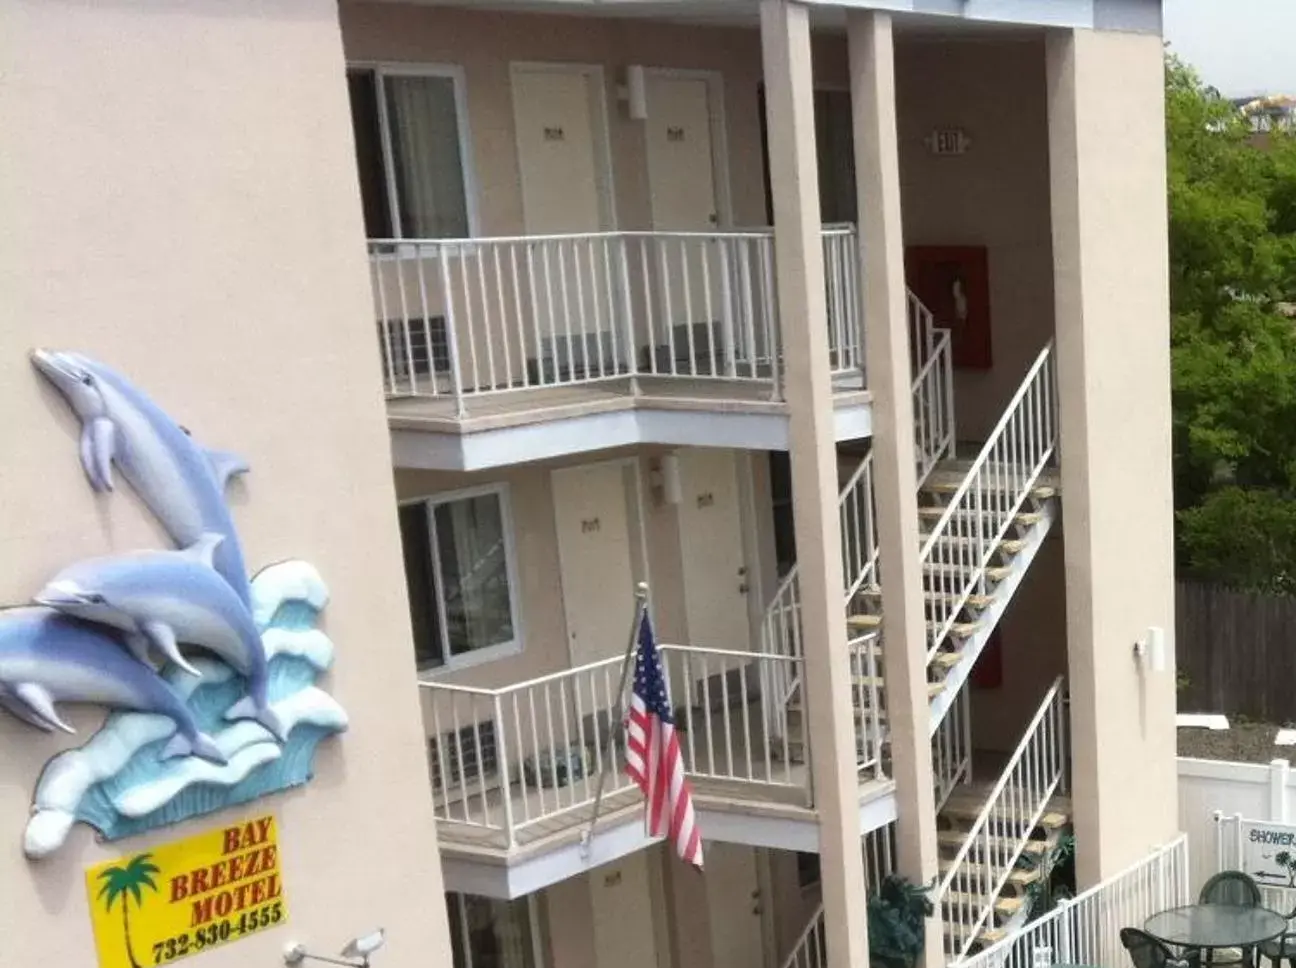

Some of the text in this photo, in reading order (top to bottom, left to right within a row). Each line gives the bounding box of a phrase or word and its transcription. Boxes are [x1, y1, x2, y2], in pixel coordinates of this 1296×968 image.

[221, 816, 273, 855] BAY
[169, 844, 277, 904] BREEZE
[190, 872, 282, 928] MOTEL
[152, 901, 282, 964] 732-830-4555
